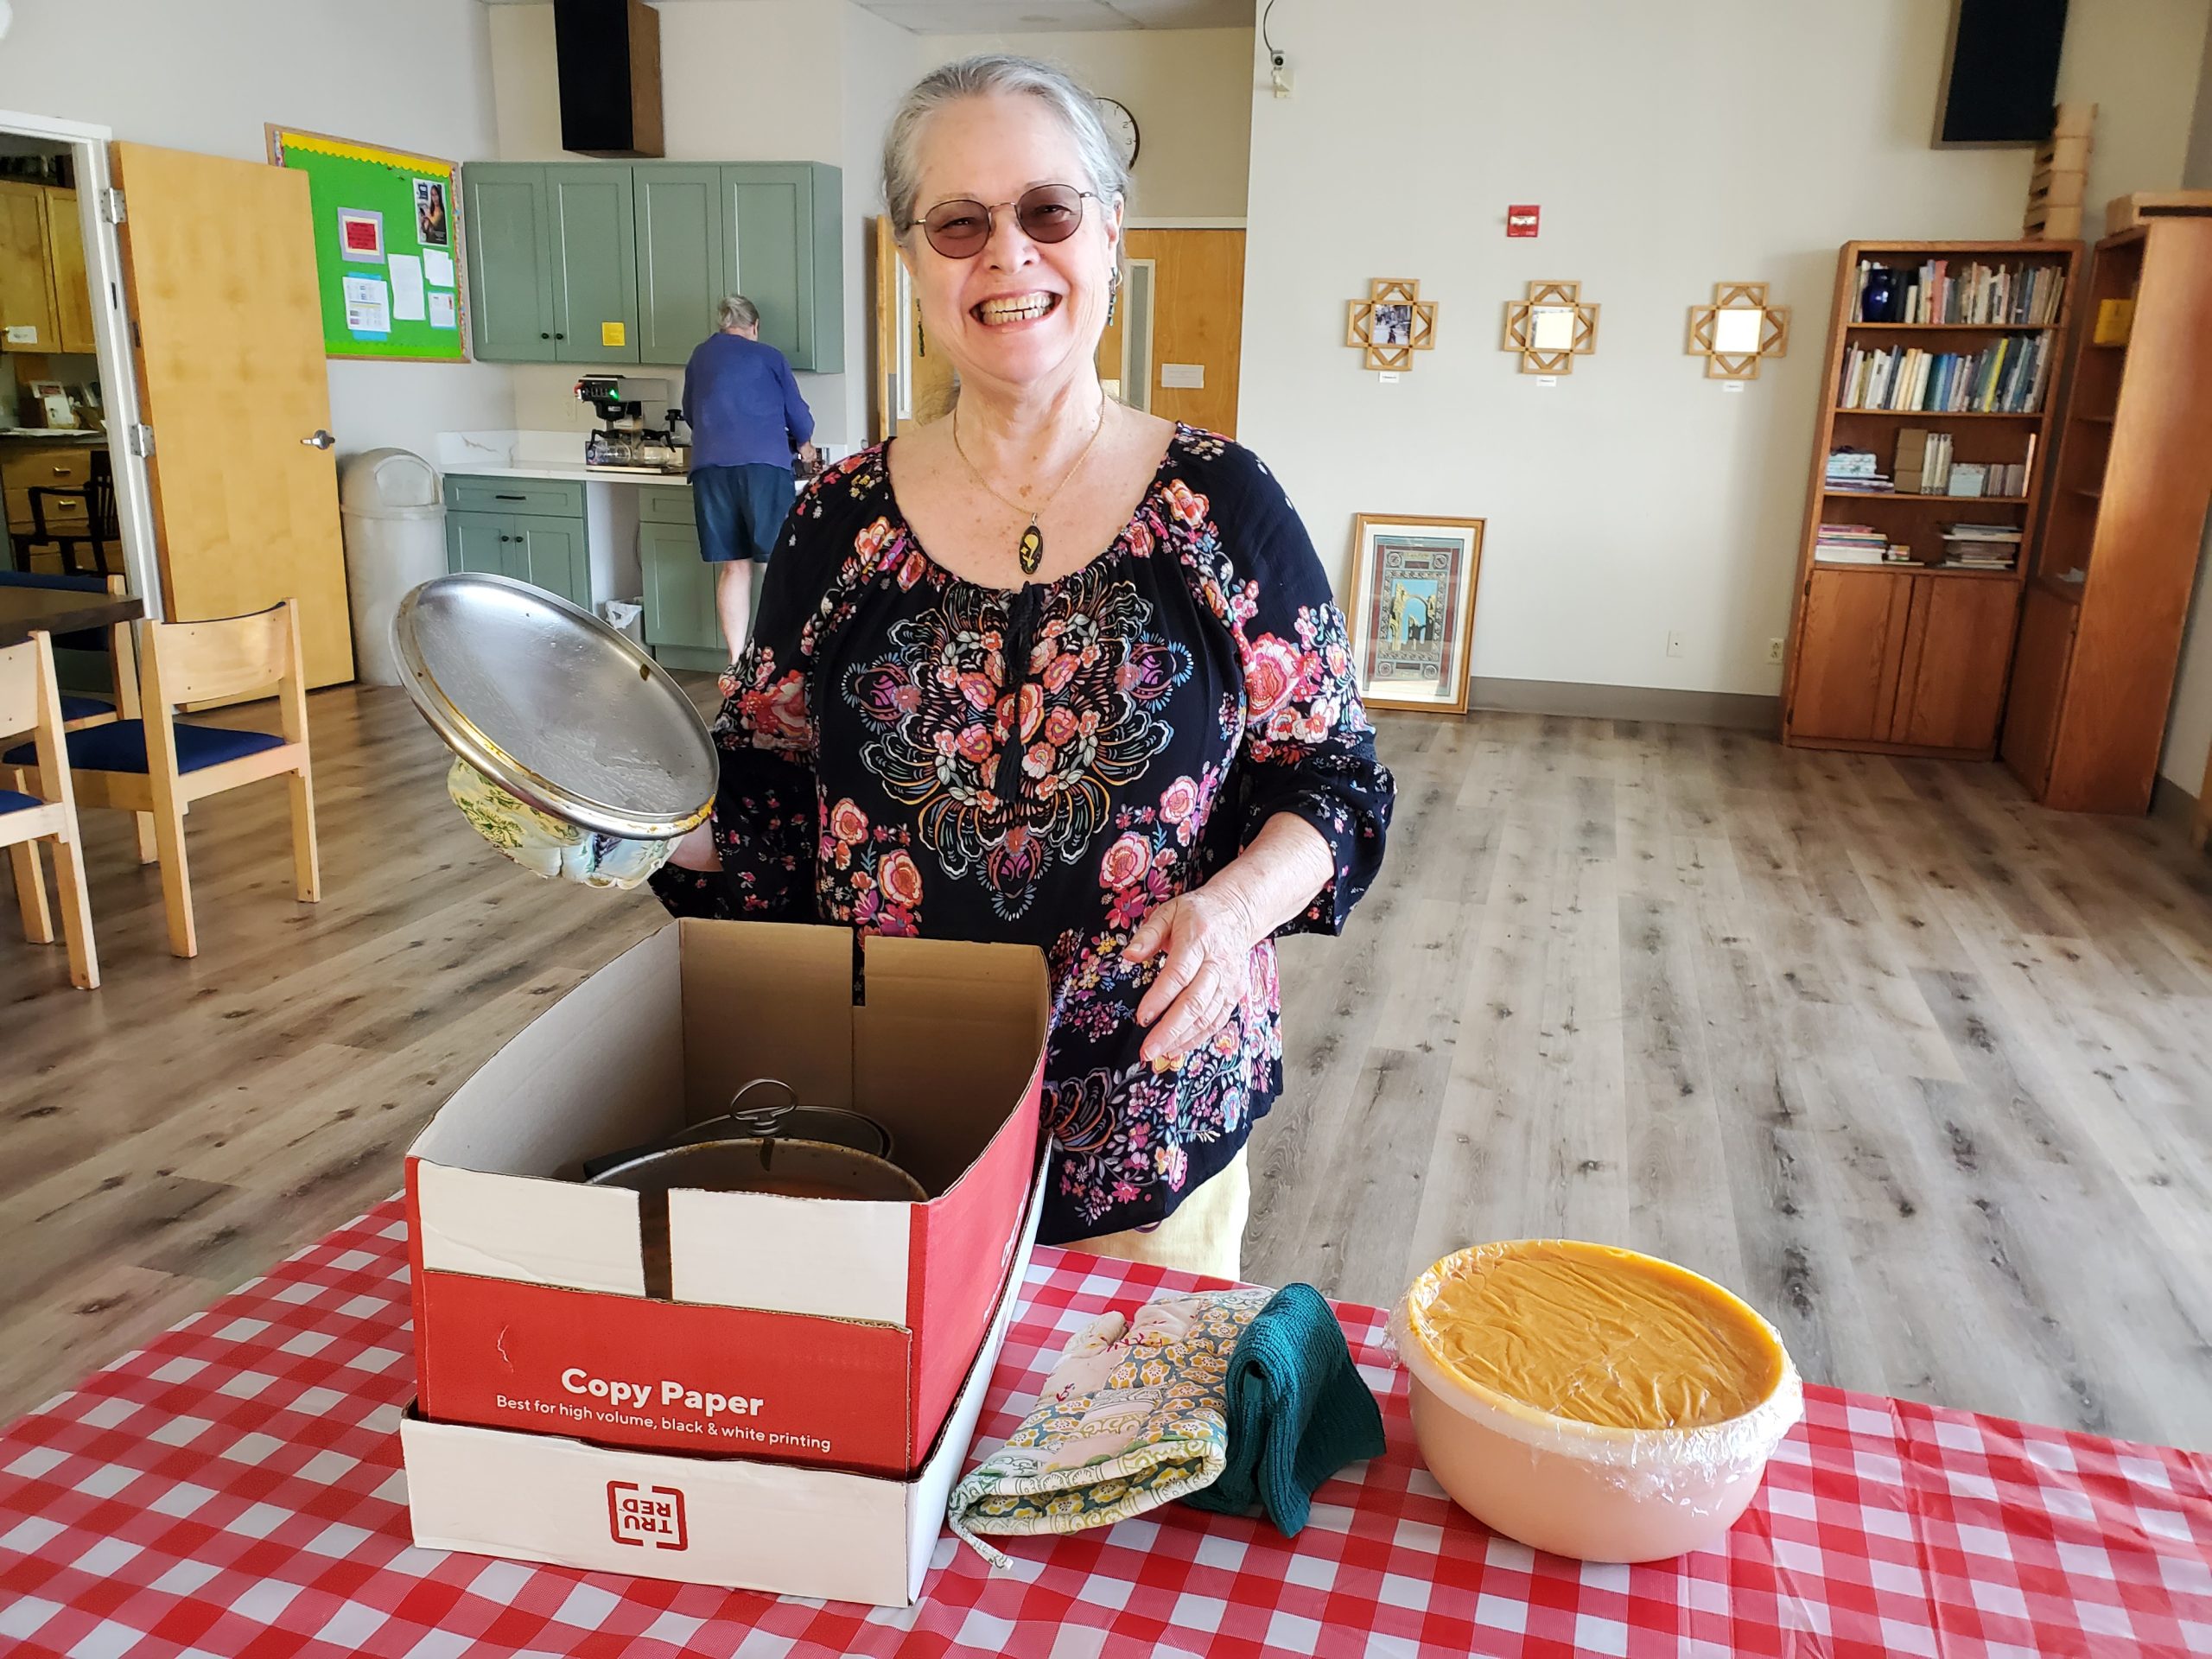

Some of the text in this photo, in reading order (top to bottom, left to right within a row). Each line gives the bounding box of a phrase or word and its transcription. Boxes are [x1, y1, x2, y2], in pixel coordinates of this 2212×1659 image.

[562, 1367, 764, 1417] Copy Paper
[496, 1395, 831, 1452] Best for high volume, black & white printing
[622, 1498, 671, 1518] RED
[624, 1515, 673, 1535] TRU
